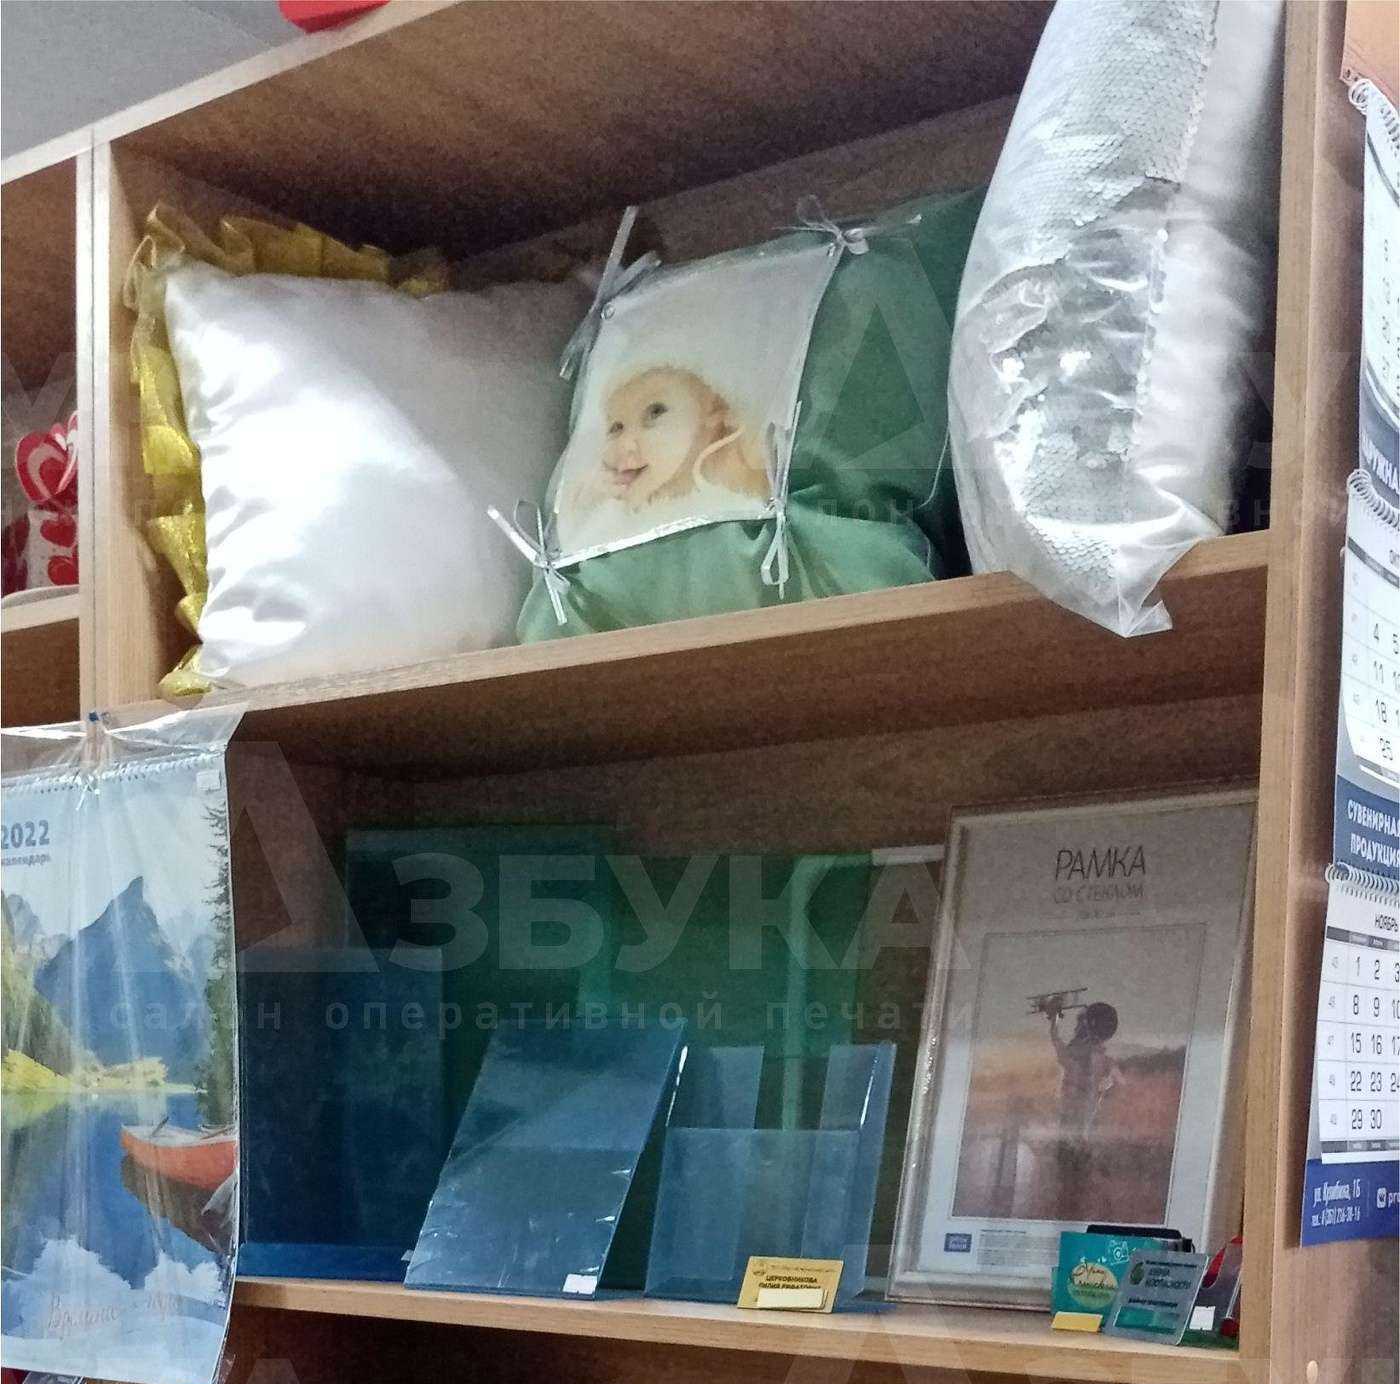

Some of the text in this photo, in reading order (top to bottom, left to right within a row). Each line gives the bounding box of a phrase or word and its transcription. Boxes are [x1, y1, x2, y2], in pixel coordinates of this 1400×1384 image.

[1055, 845, 1146, 881] РАМКА
[1374, 959, 1380, 980] 2
[1353, 994, 1360, 1016] 8
[1373, 997, 1380, 1017] 9
[1351, 1033, 1362, 1054] 15
[1371, 1034, 1383, 1055] 16
[1350, 1070, 1362, 1092] 22
[1370, 1071, 1382, 1092] 23
[1351, 1109, 1382, 1130] 29 30
